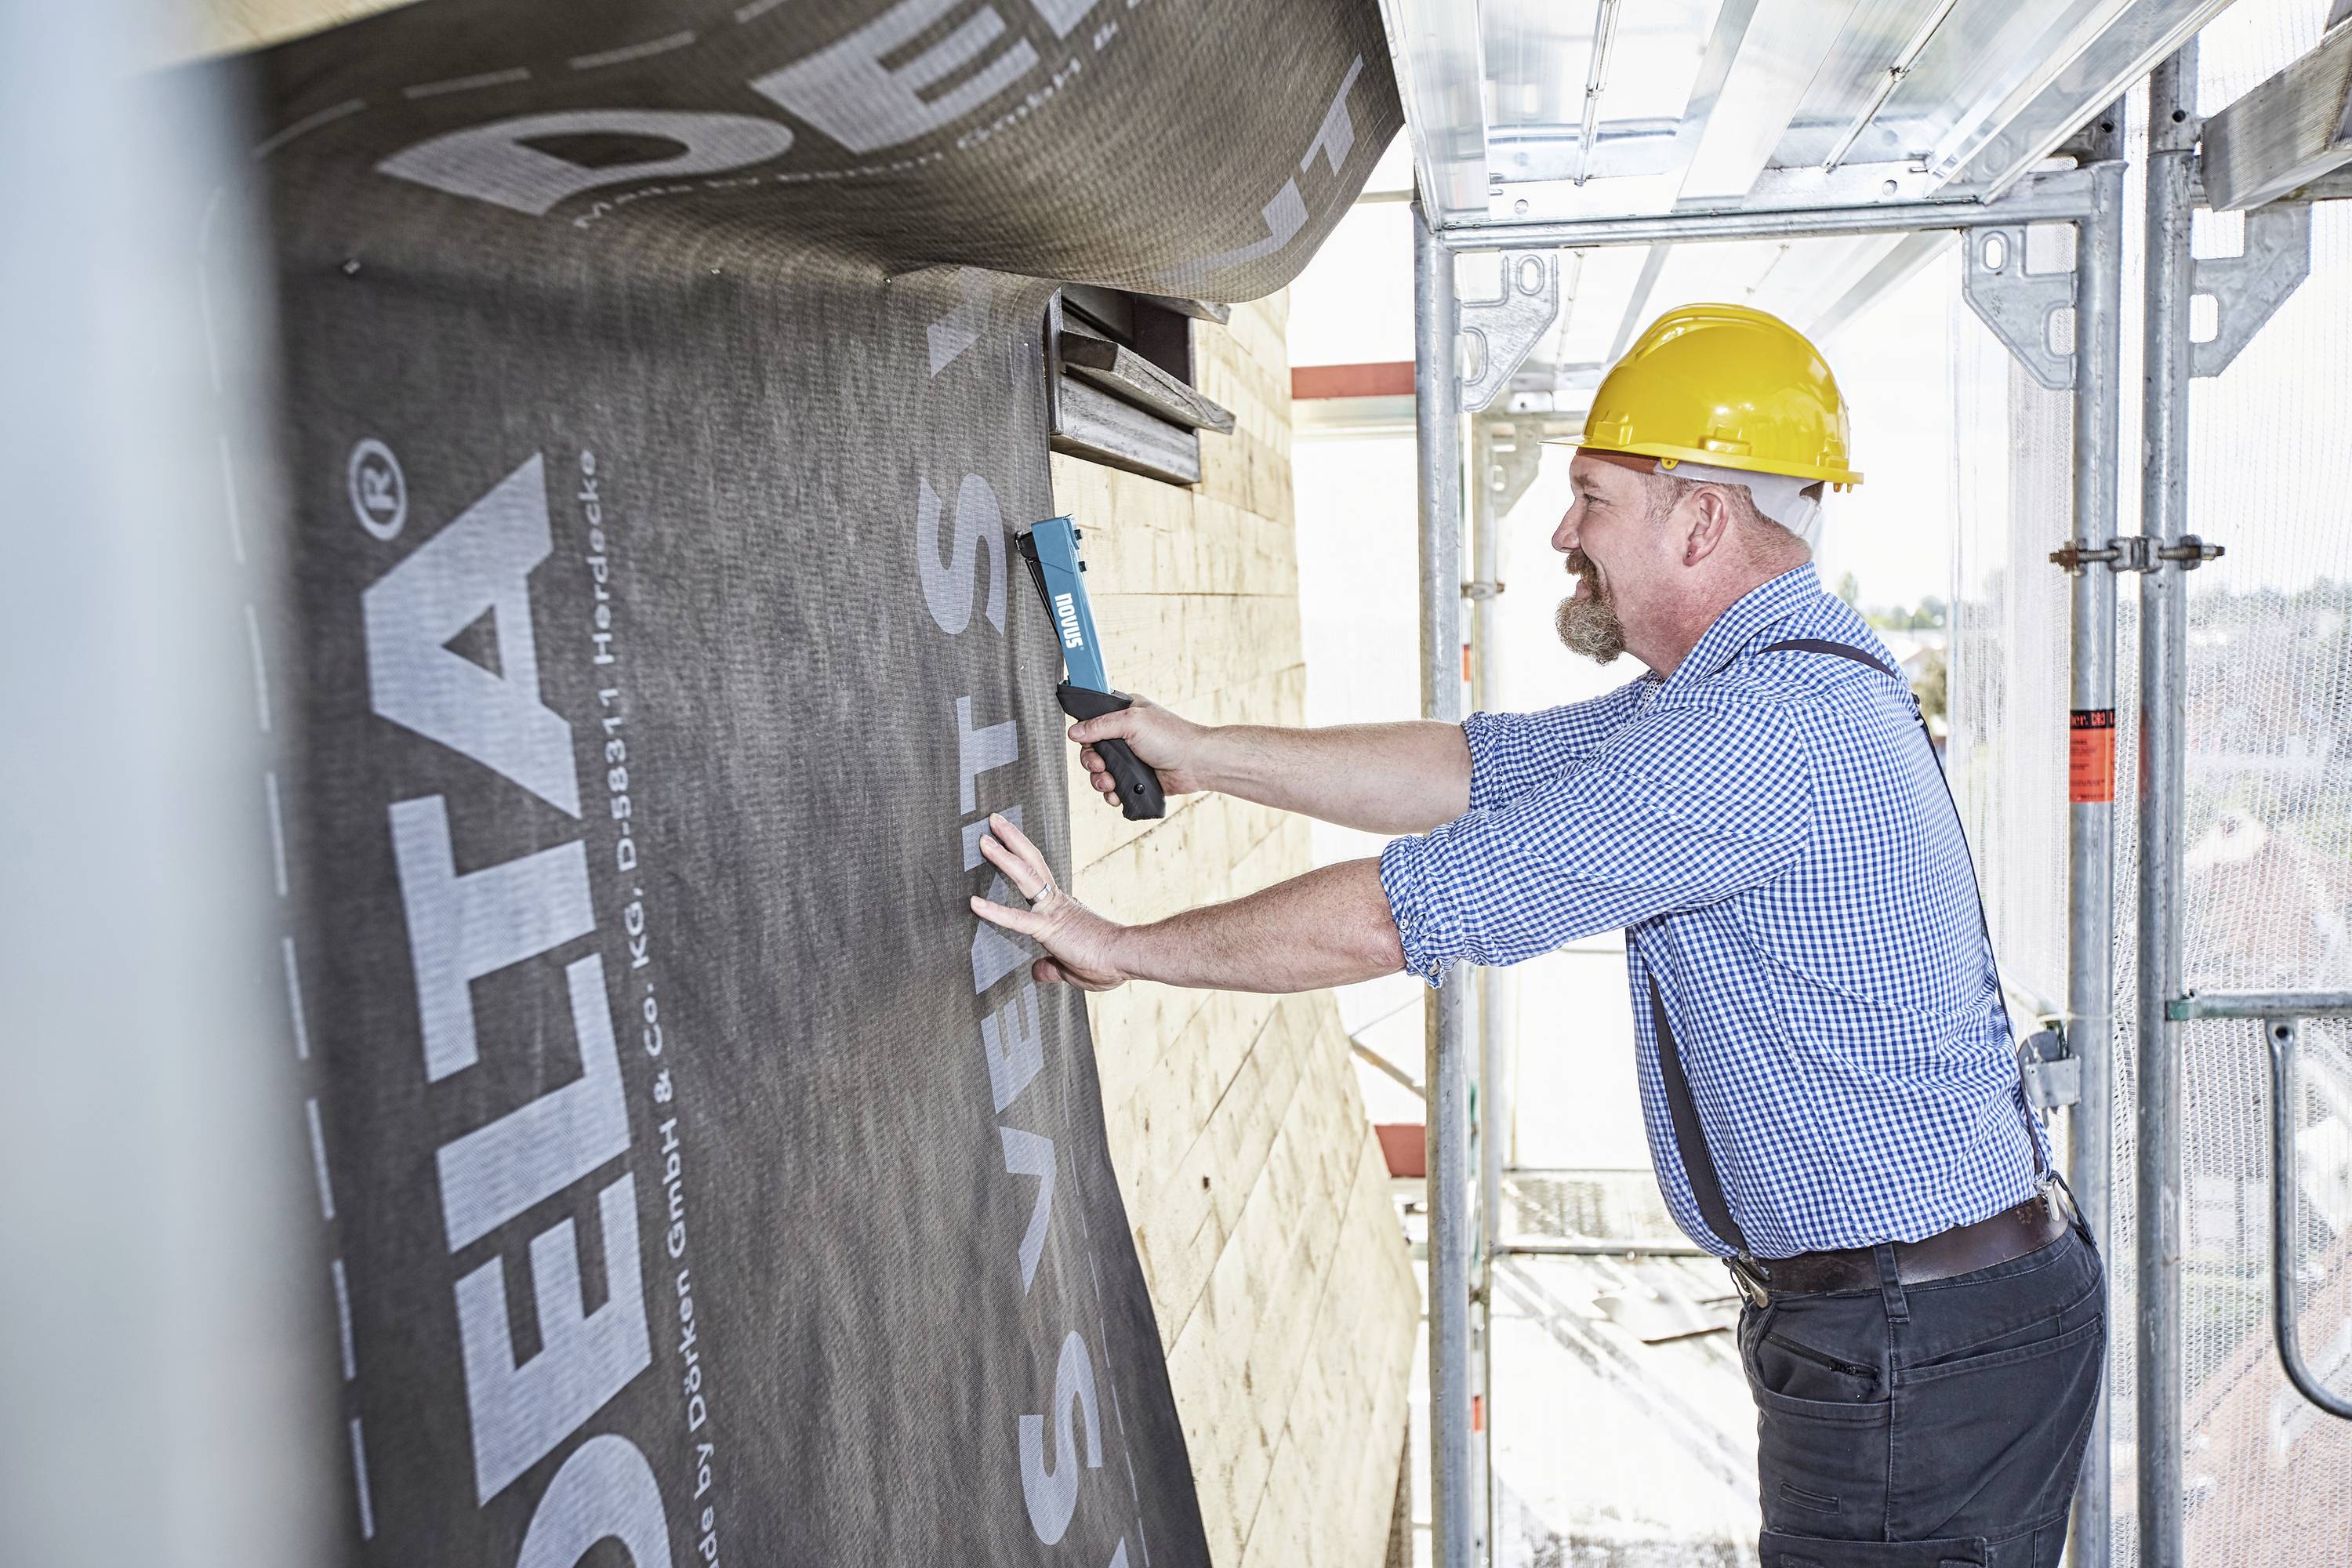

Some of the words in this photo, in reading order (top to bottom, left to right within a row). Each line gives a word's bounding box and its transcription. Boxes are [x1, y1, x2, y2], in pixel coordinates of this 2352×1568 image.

[375, 0, 1099, 216] DE
[578, 449, 615, 665] Herdecke
[916, 472, 1008, 637] S
[598, 688, 637, 873] D-58311
[624, 887, 650, 969] KG,
[643, 982, 663, 1058] Co.
[653, 1068, 673, 1104] &
[659, 1117, 686, 1260] GmbH
[676, 1269, 707, 1433] Dörken
[693, 1443, 714, 1501] by
[1018, 1330, 1102, 1546] S
[698, 1505, 720, 1568] de
